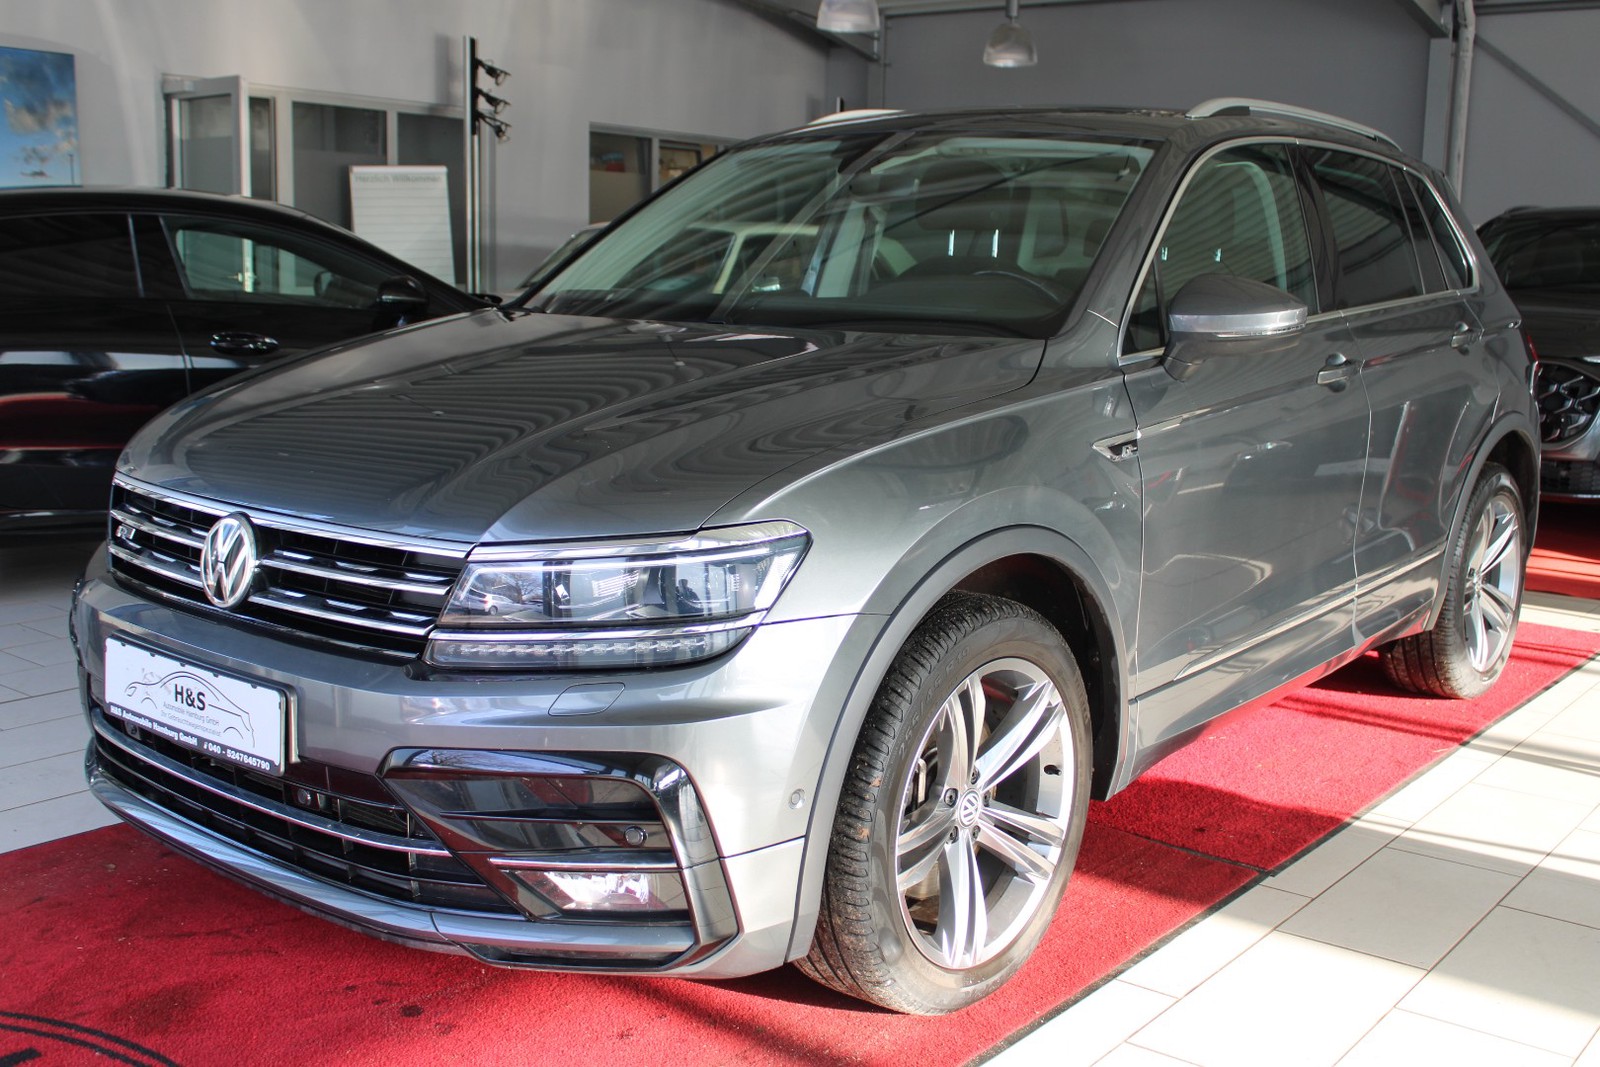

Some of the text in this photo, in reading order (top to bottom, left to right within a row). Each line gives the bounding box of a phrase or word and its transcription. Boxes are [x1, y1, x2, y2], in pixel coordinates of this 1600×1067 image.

[174, 683, 206, 711] H&S
[122, 709, 153, 729] Automobile
[152, 721, 179, 741] Hamburg
[178, 731, 198, 746] GmbH
[208, 742, 221, 755] 040
[226, 748, 271, 771] 5247645790
